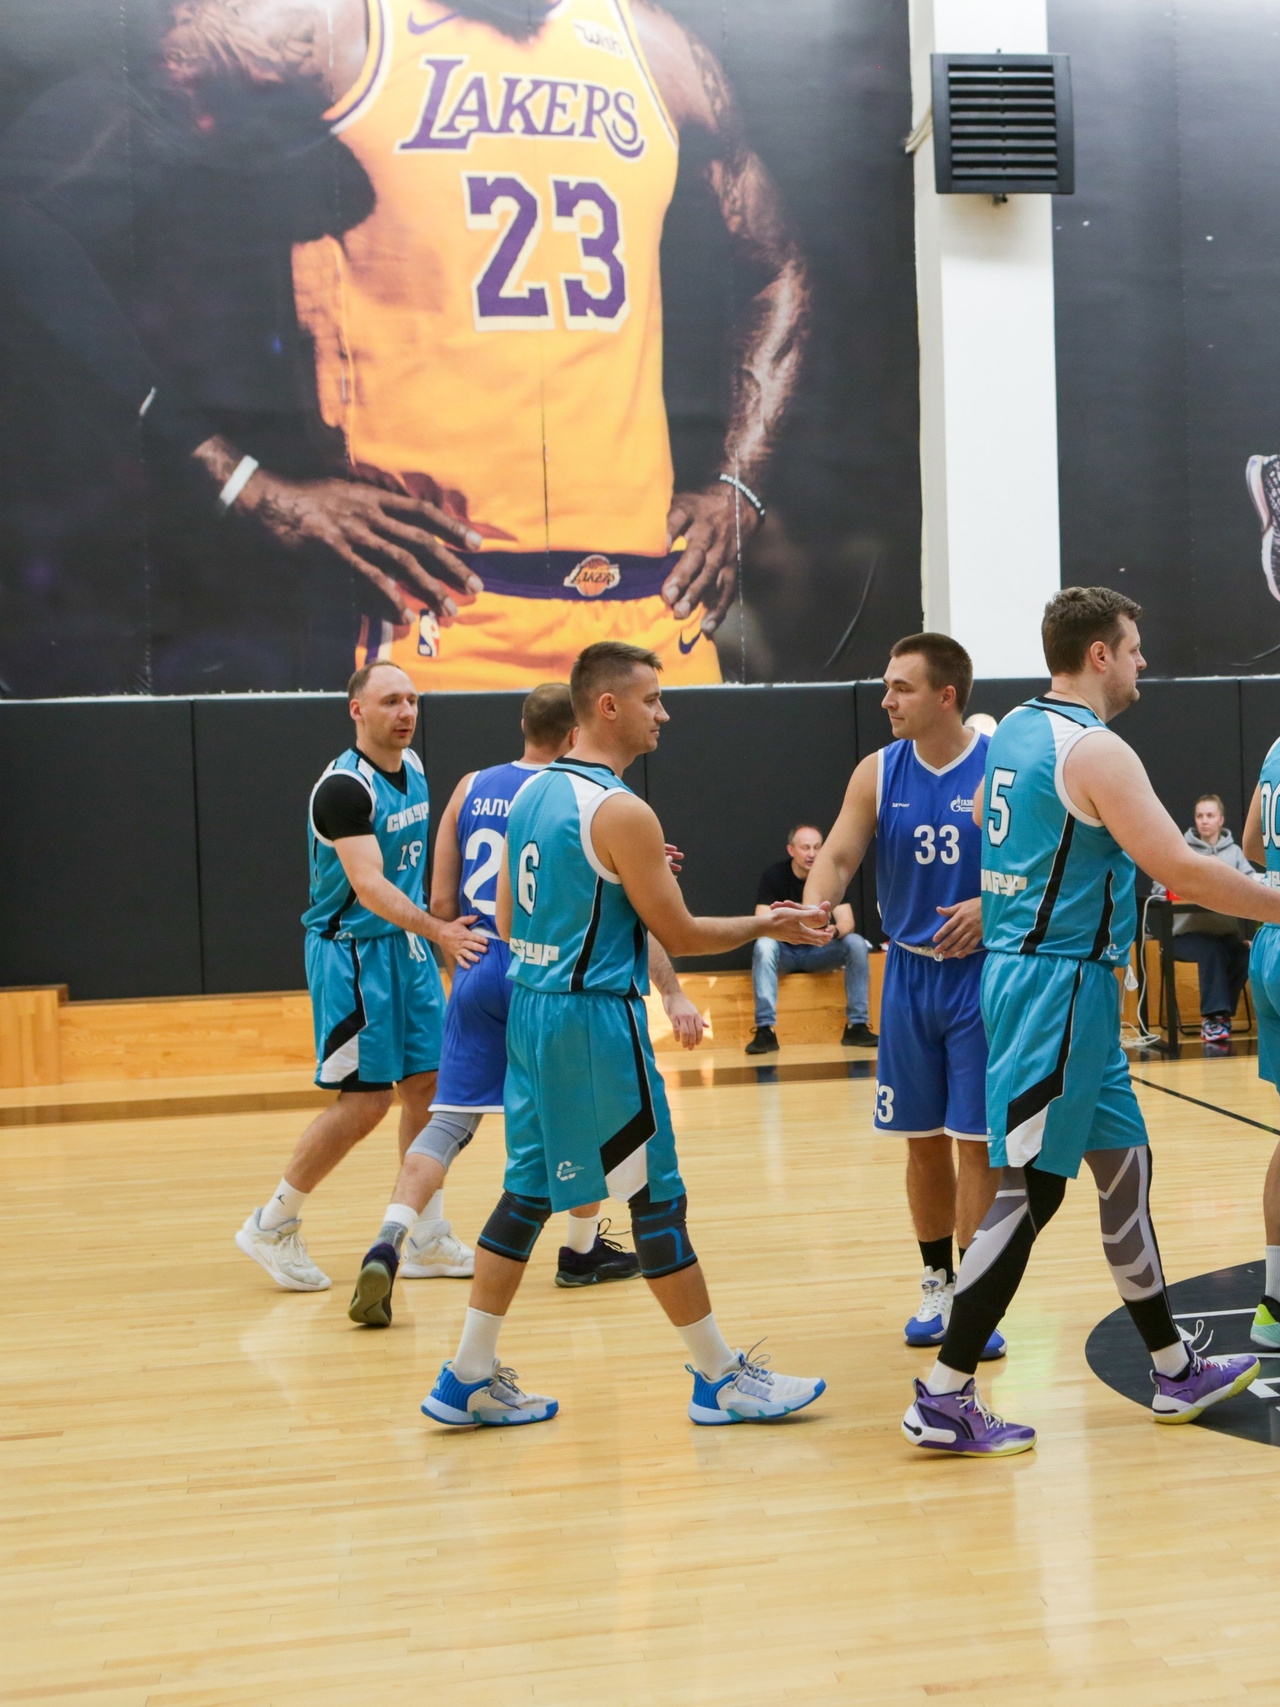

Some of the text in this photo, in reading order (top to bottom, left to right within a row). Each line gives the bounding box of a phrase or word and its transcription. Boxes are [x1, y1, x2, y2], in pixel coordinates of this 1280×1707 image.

[461, 172, 630, 332] 23
[914, 824, 960, 865] 33
[987, 766, 1017, 848] 5
[517, 840, 541, 917] 6
[875, 1079, 895, 1124] 3
